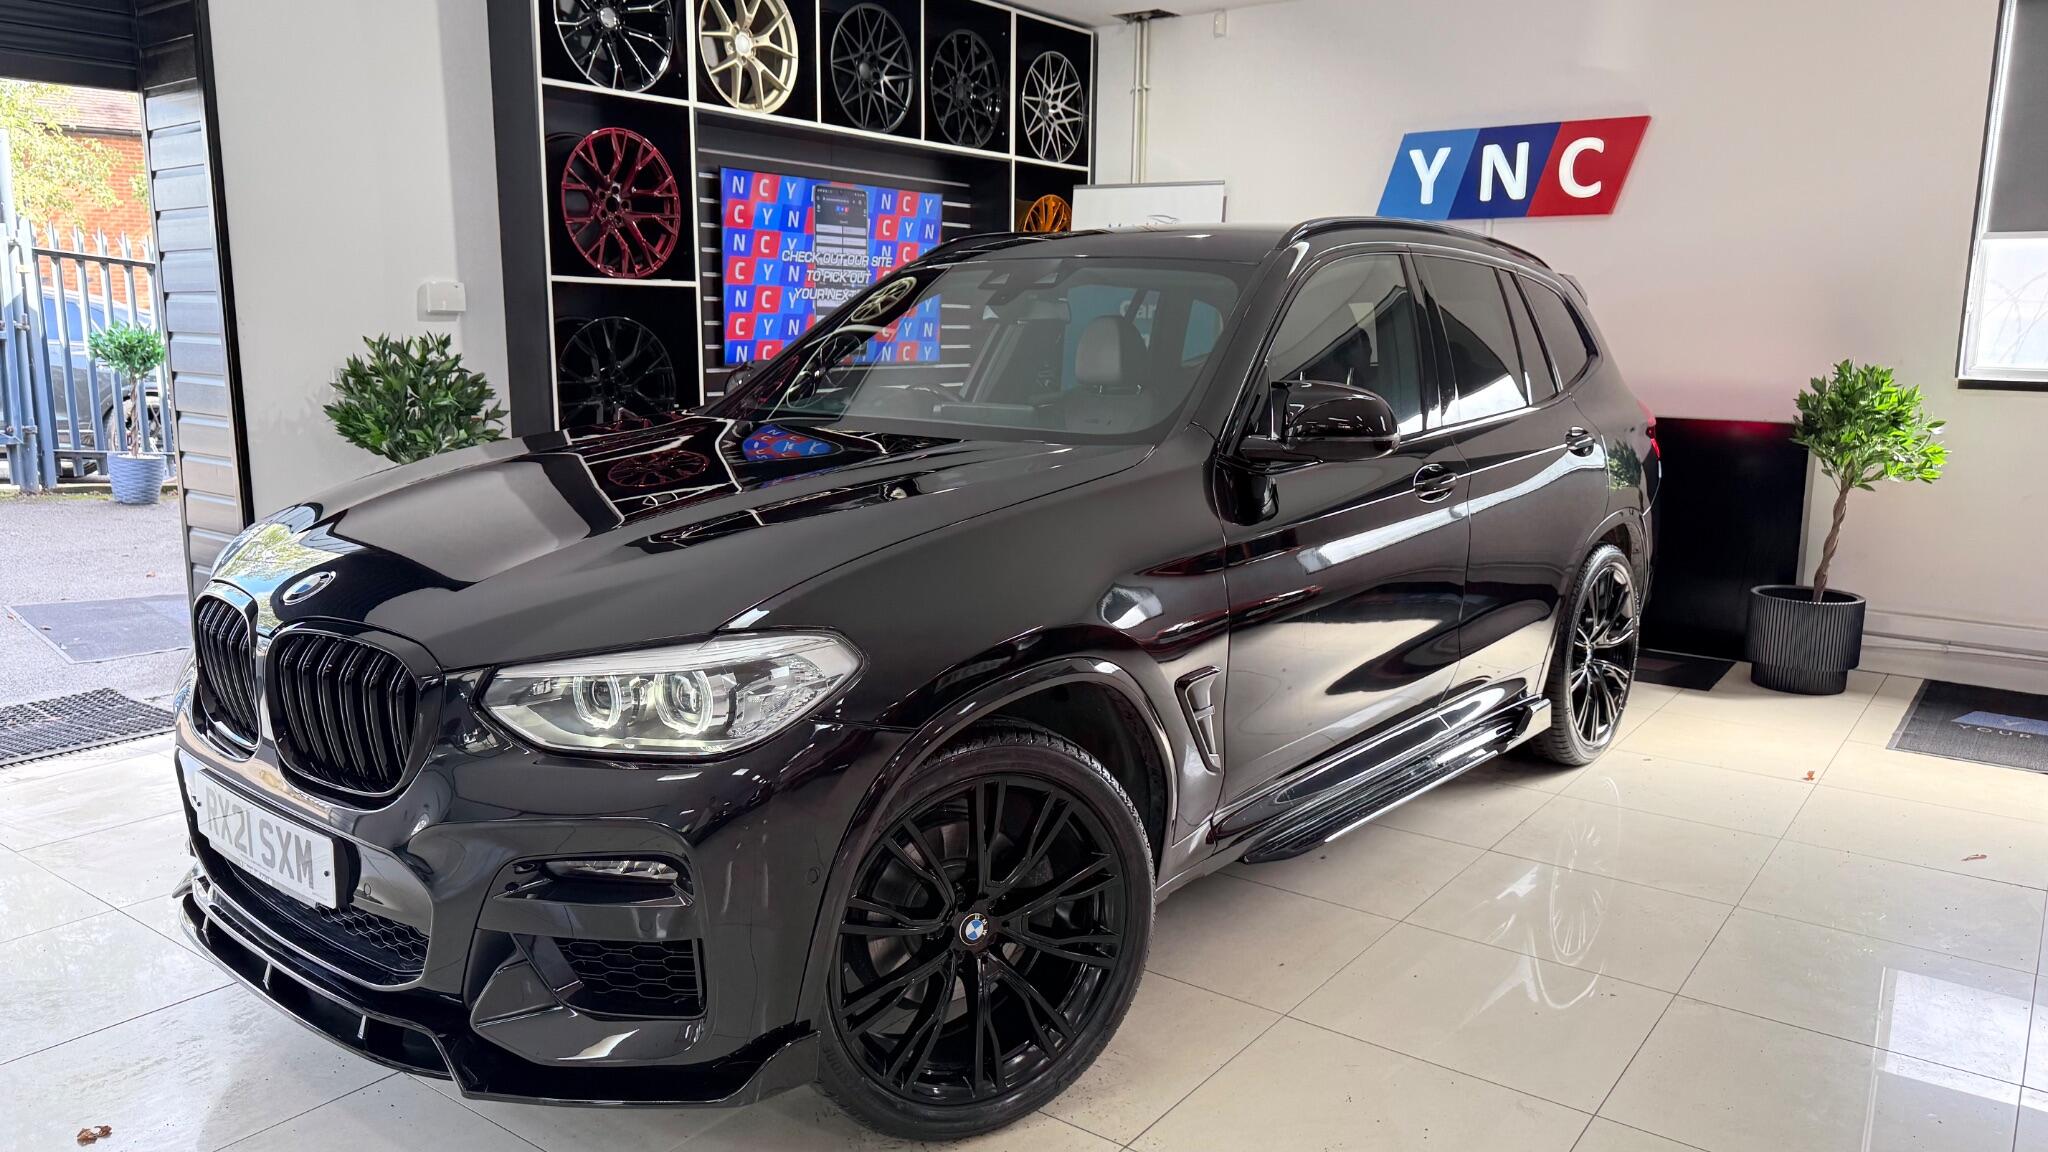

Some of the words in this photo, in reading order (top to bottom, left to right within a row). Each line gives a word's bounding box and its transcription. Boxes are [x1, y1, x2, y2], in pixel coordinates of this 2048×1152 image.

[1409, 137, 1605, 205] YNC
[782, 250, 820, 263] CHECK
[823, 253, 846, 264] OUT
[848, 255, 869, 266] OUR
[871, 256, 893, 267] SITE
[806, 270, 822, 282] TO
[823, 270, 847, 283] PICK
[850, 271, 872, 283] OUT
[794, 287, 825, 300] YOUR
[1960, 724, 2031, 738] YOUR
[206, 786, 253, 858] RX21
[259, 818, 314, 890] SXM
